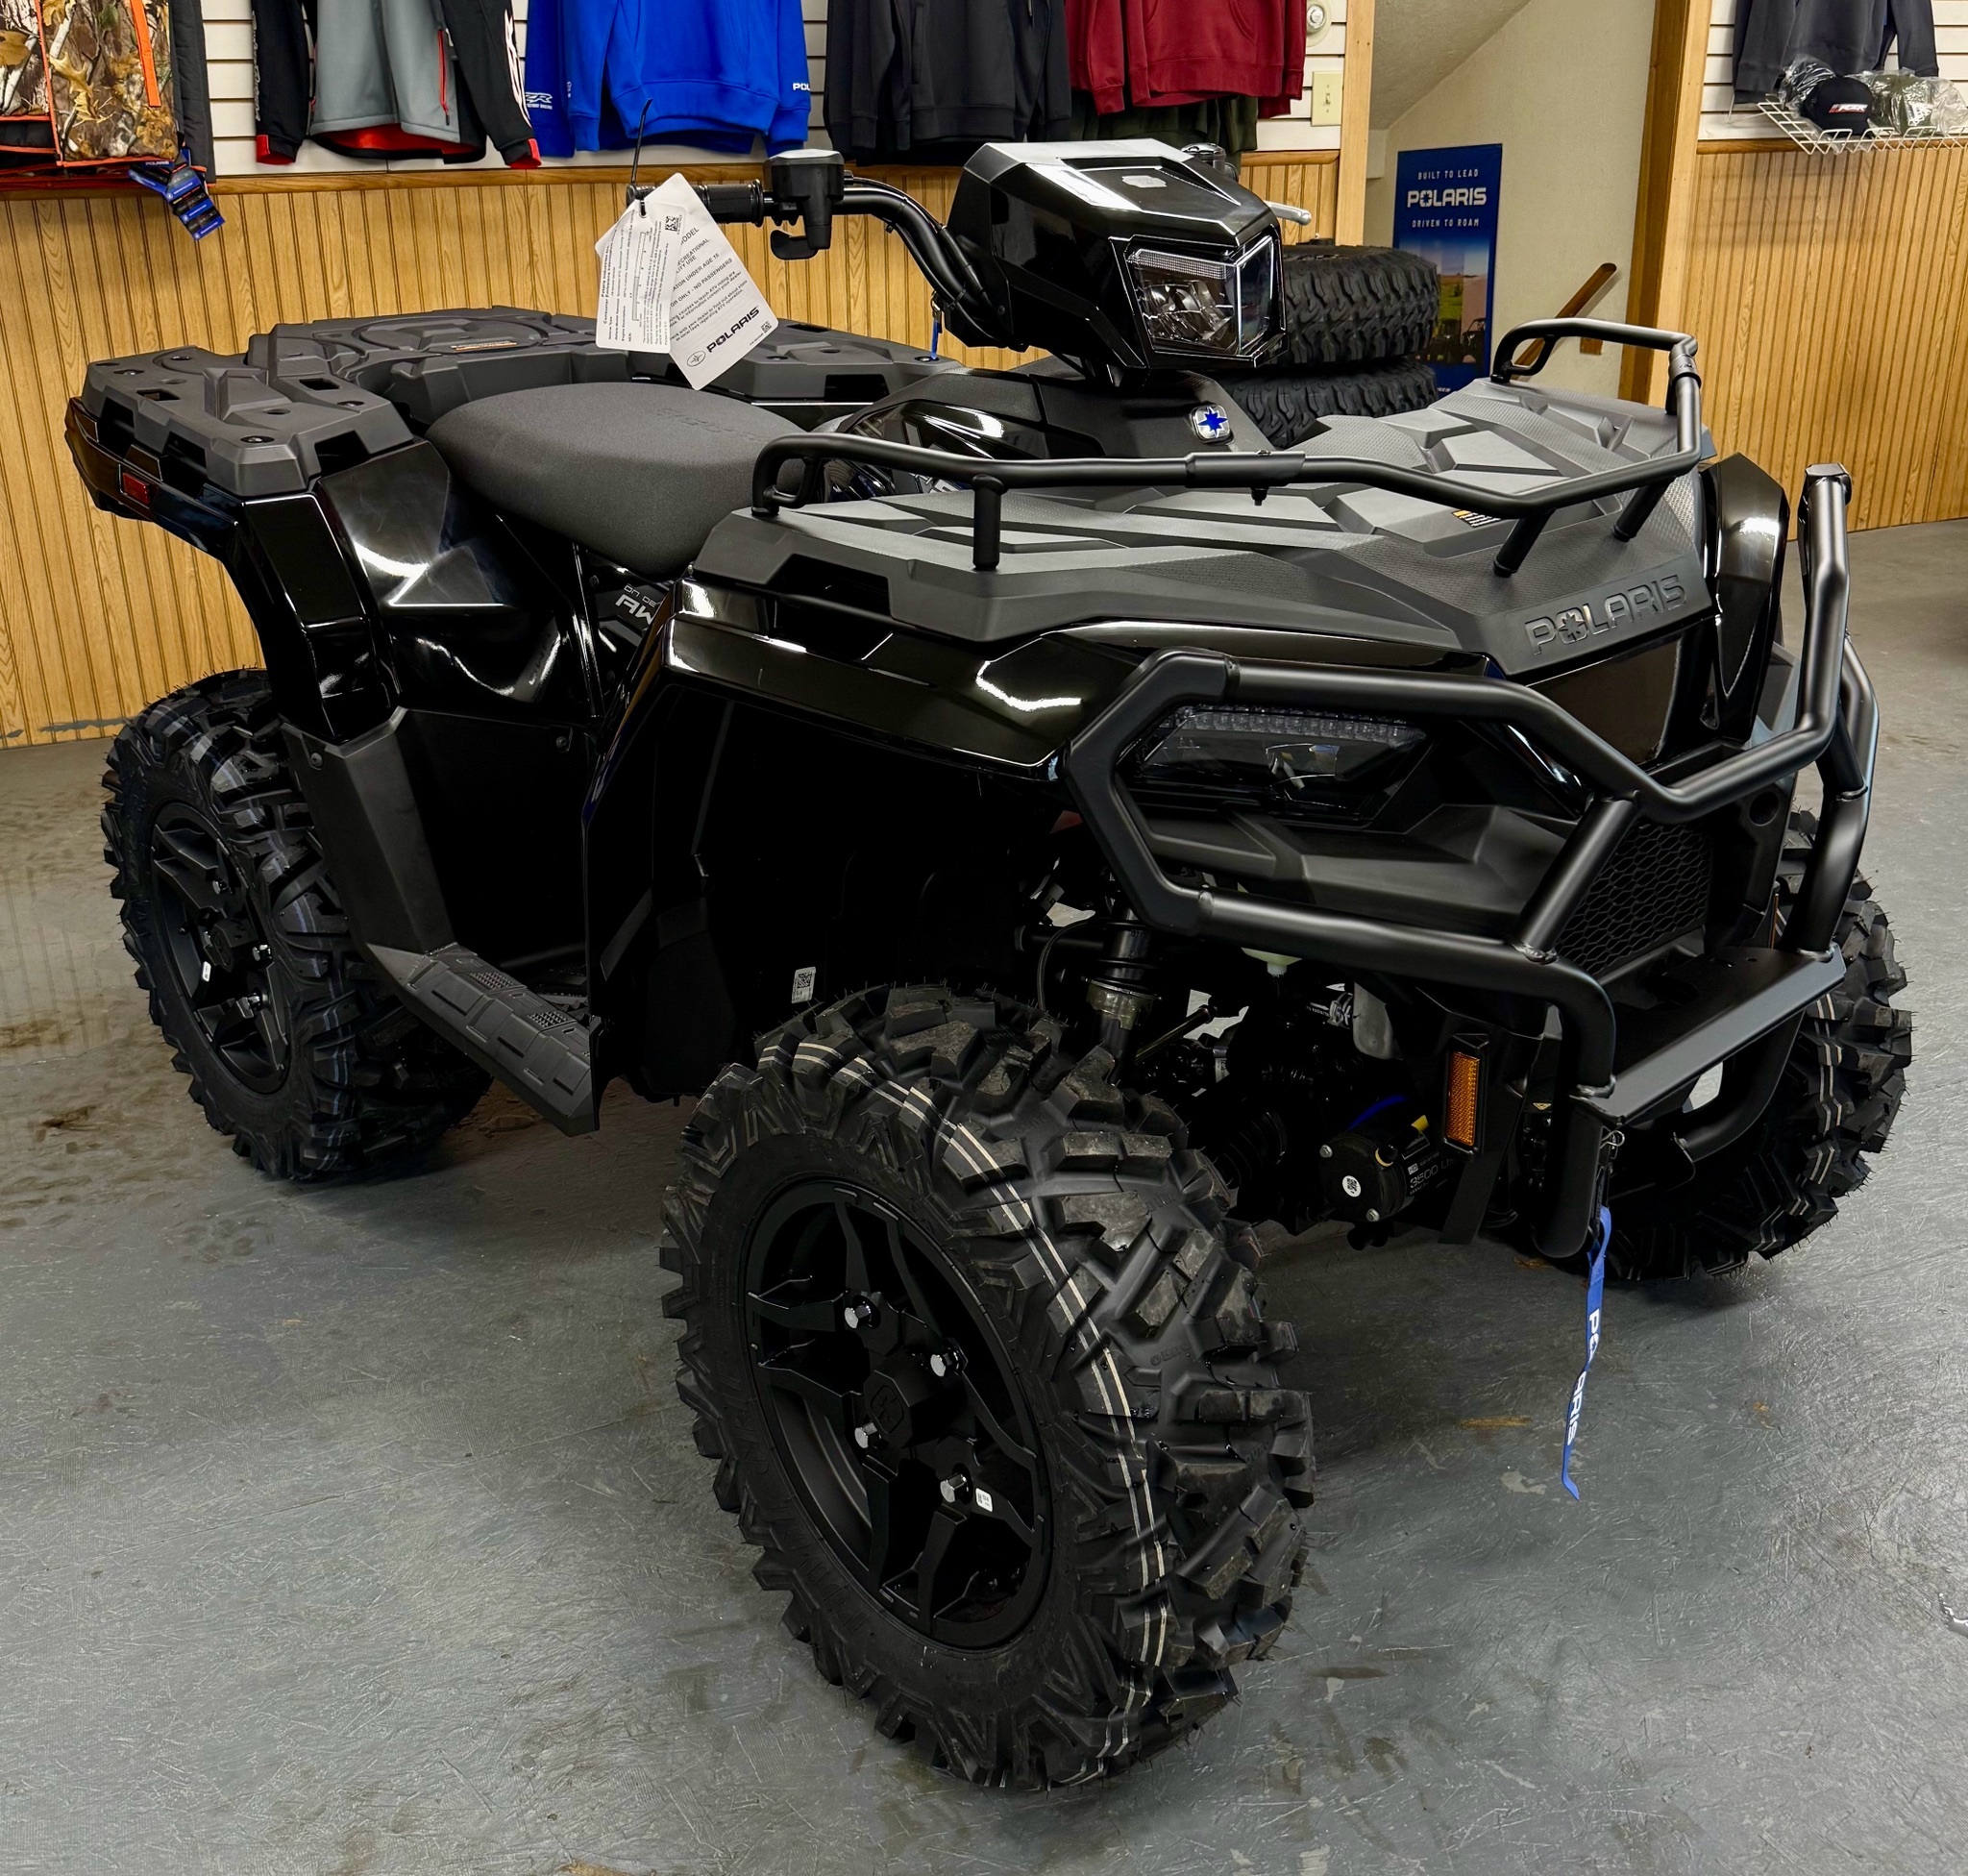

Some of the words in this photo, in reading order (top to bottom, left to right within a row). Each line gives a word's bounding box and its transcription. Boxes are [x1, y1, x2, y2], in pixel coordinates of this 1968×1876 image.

[1417, 171, 1440, 180] BUILT
[1458, 168, 1479, 178] LEAD
[1407, 187, 1487, 208] POLARIS
[1457, 218, 1479, 227] ROAM
[677, 238, 710, 266] ECREATIONAL
[685, 255, 697, 265] USE
[673, 279, 687, 292] ATOR
[685, 265, 703, 282] UNDER
[702, 258, 714, 268] AGE
[678, 290, 691, 304] ONLY
[701, 259, 732, 284] PASSENGERS
[706, 306, 760, 353] POLARIS
[624, 583, 640, 597] ON
[1525, 574, 1687, 655] POLARIS
[1410, 1164, 1439, 1188] 3500
